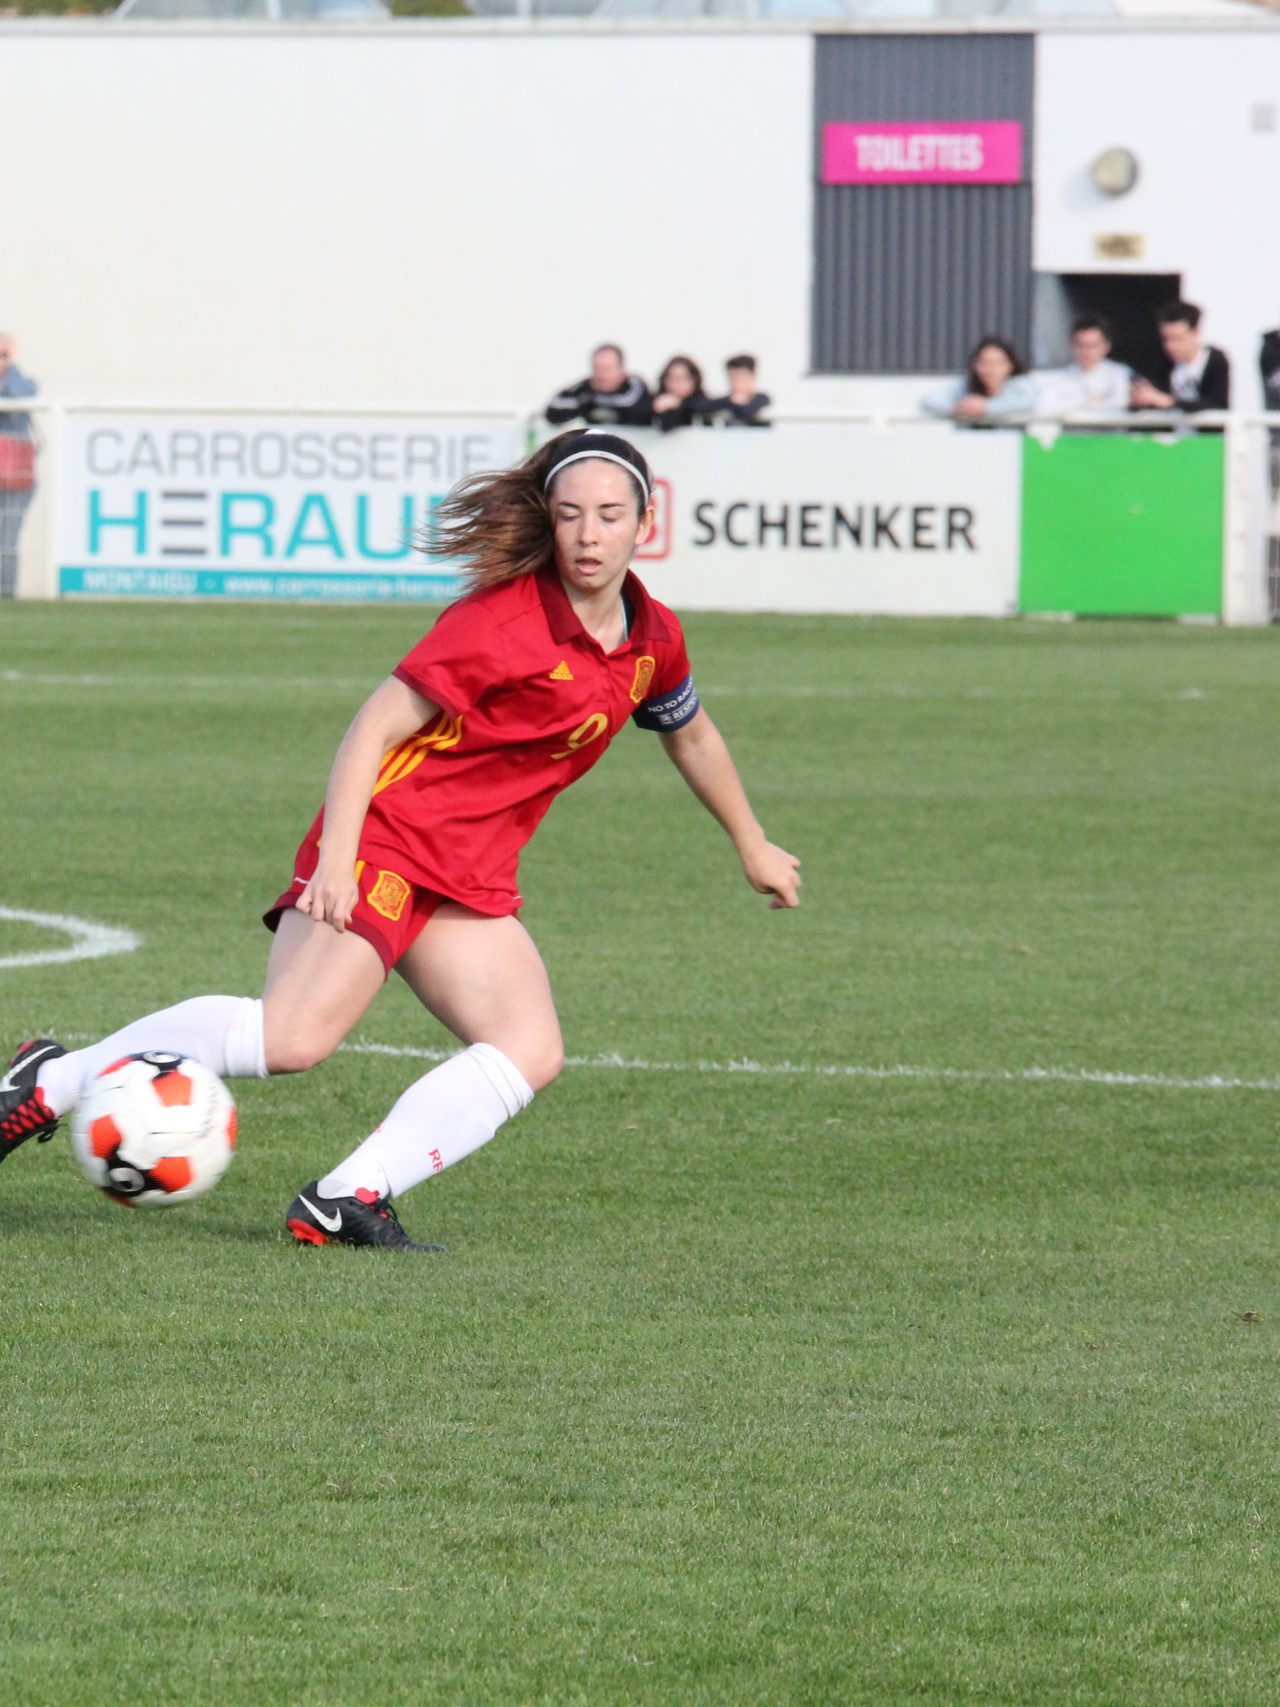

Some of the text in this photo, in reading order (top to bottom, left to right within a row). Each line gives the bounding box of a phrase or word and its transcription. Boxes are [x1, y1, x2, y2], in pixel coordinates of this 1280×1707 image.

[854, 134, 983, 171] TOILETTES
[85, 429, 492, 482] CARROSSERIE
[694, 501, 976, 550] SCHENKER
[664, 700, 678, 709] TO
[549, 712, 609, 760] 9
